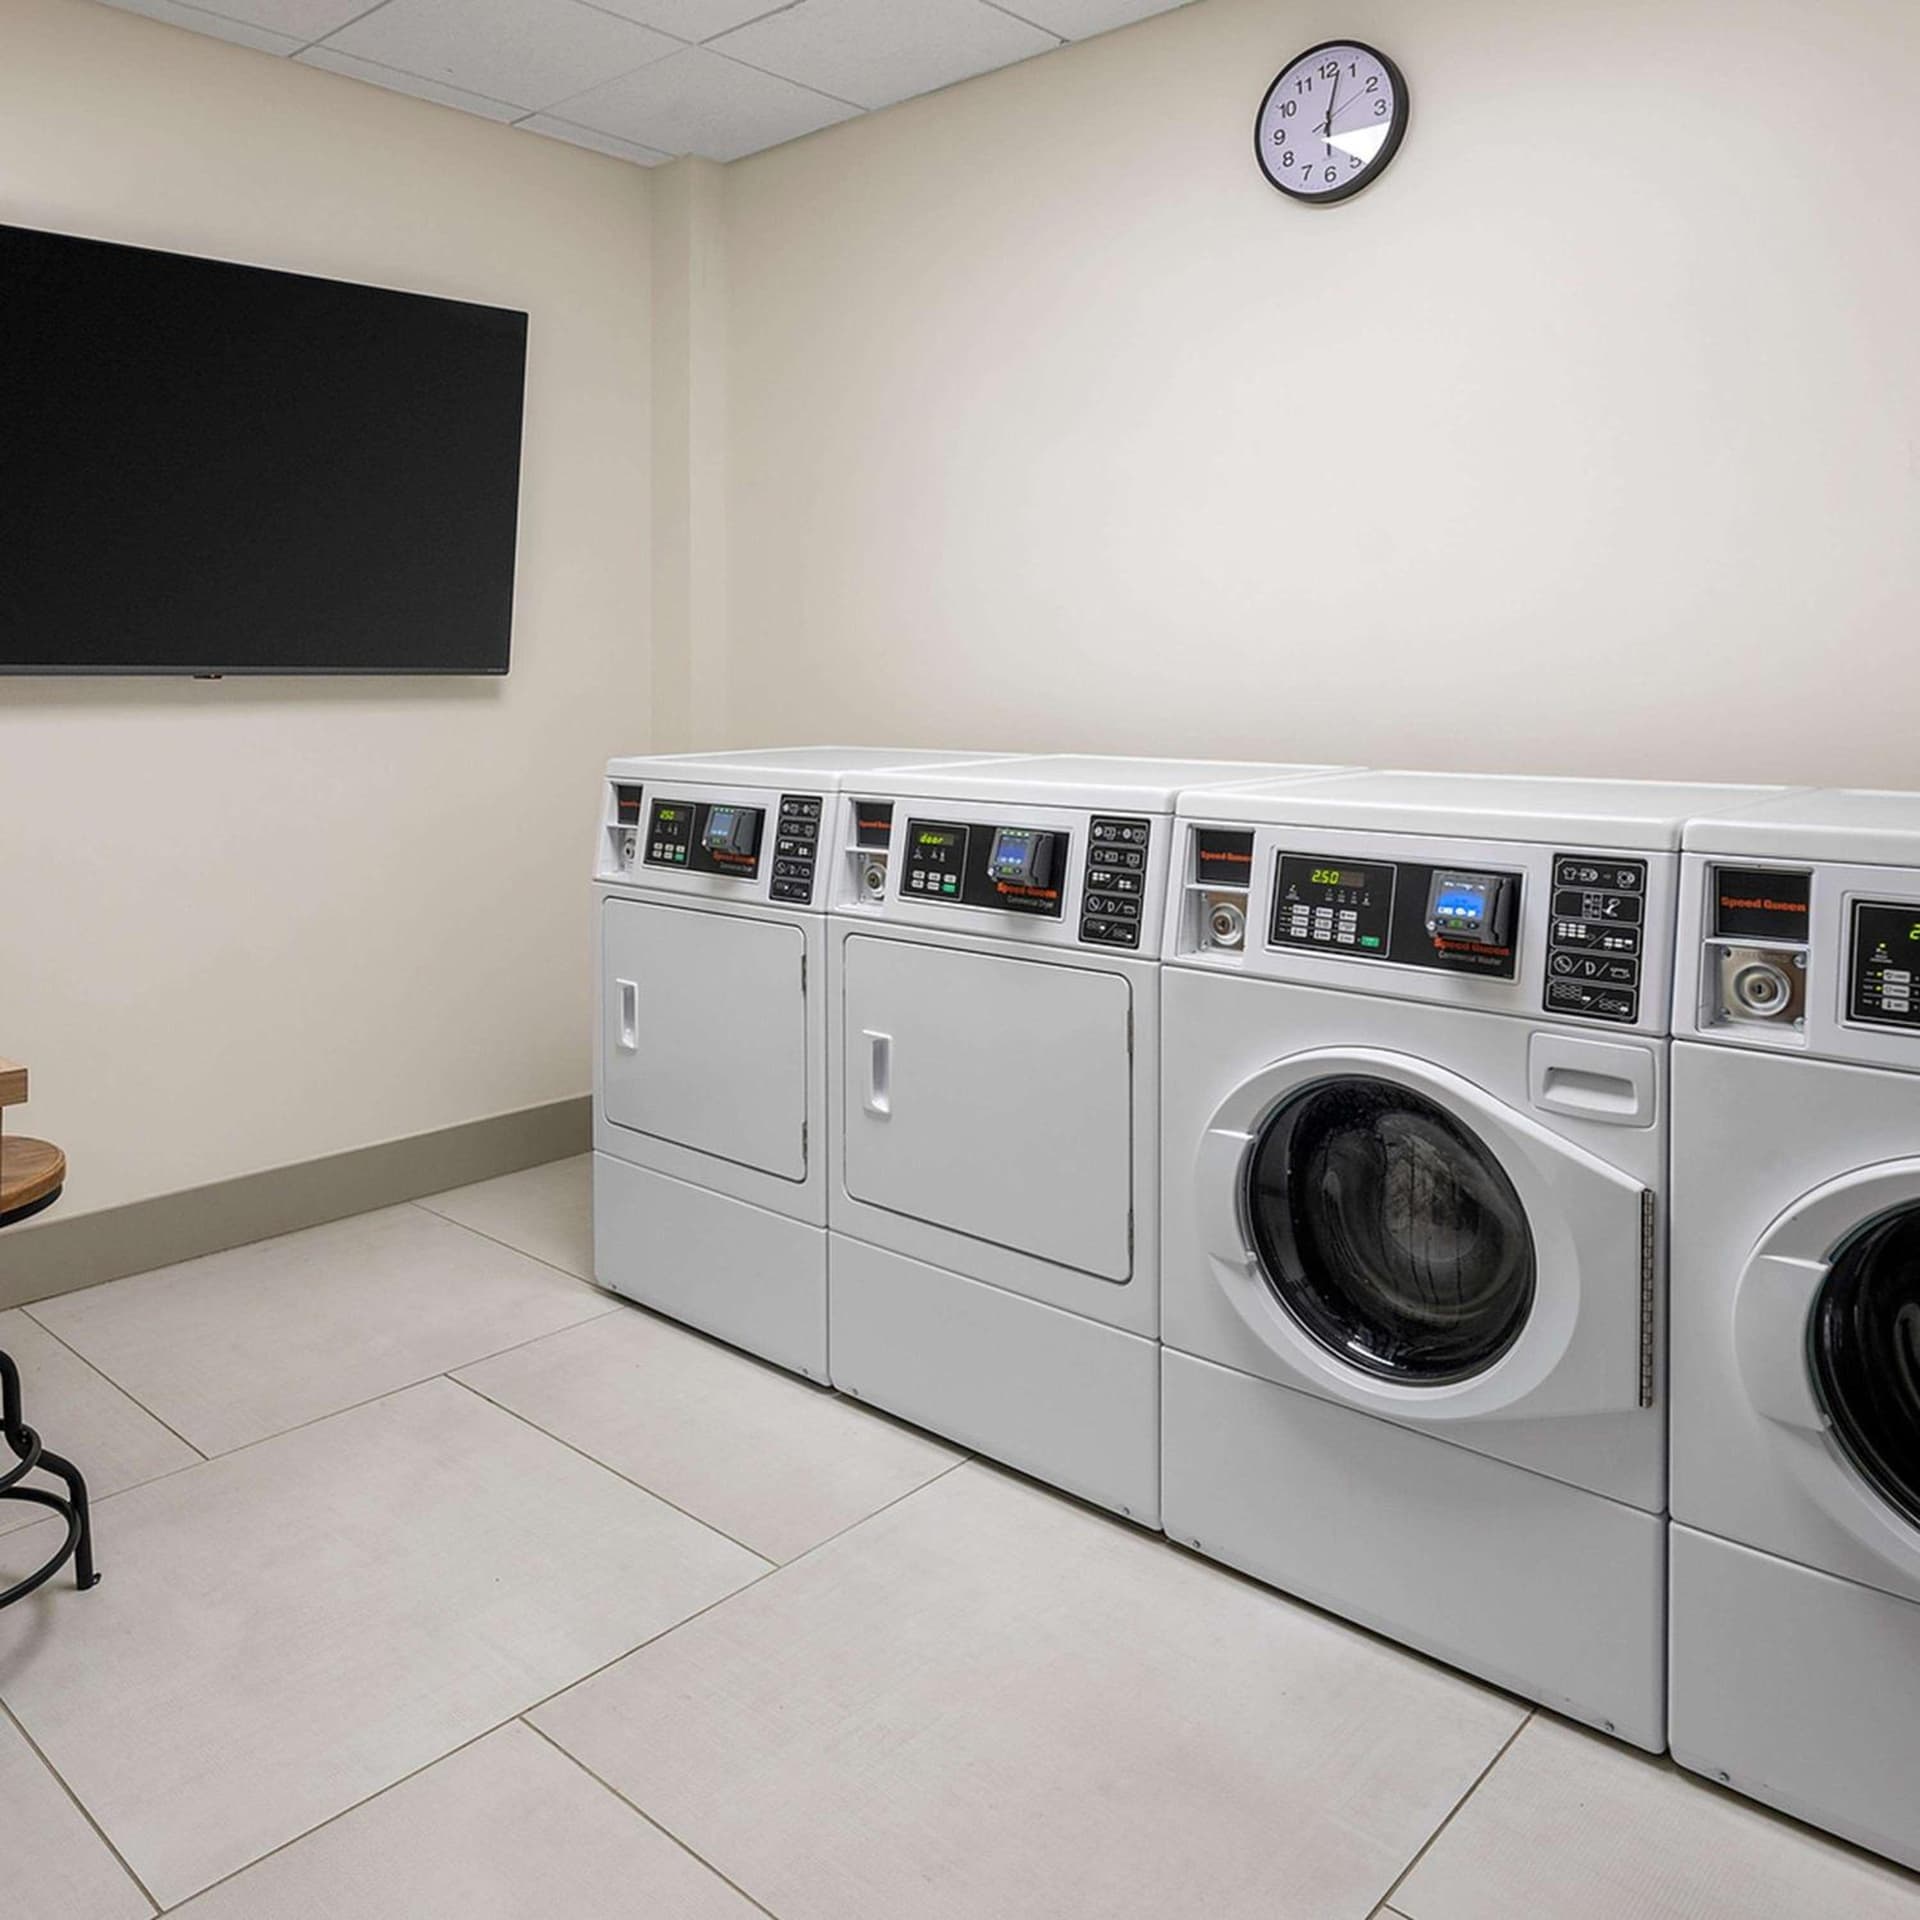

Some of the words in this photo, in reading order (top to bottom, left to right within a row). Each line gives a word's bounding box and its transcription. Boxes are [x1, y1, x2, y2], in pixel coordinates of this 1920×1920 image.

[1317, 61, 1339, 80] 12
[1348, 63, 1356, 78] 1
[1295, 77, 1312, 94] 11
[1365, 76, 1379, 93] 2
[1279, 100, 1297, 118] 10
[1373, 98, 1387, 116] 3
[1273, 129, 1286, 146] 9
[1282, 151, 1295, 168] 8
[1301, 164, 1313, 181] 7
[1324, 166, 1337, 183] 6
[1720, 896, 1762, 909] Speed
[1763, 899, 1807, 912] Queen
